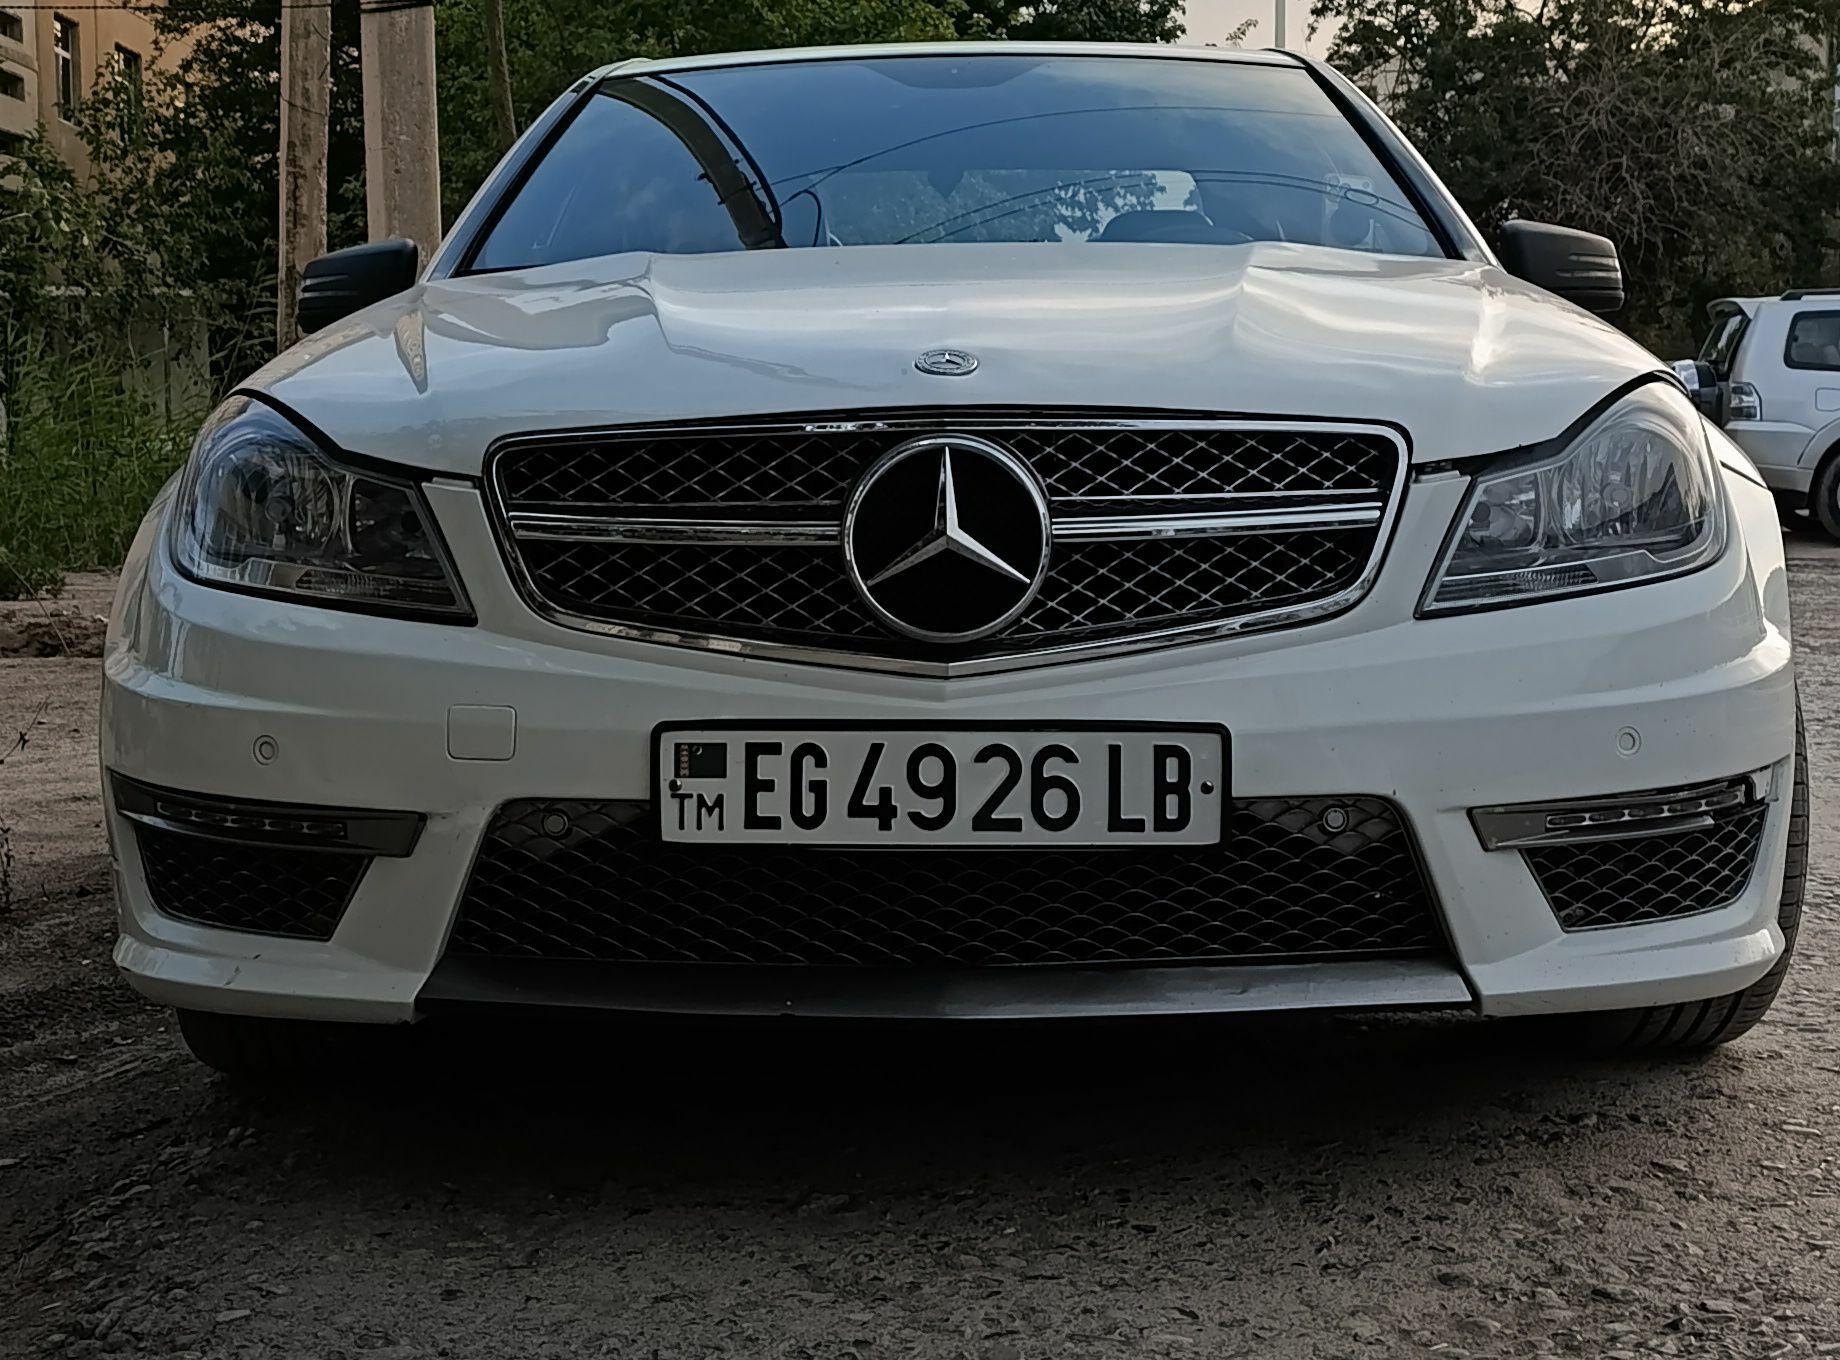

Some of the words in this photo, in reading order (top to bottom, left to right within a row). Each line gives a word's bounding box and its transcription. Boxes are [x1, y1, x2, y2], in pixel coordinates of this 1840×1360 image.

[669, 793, 725, 831] TM
[744, 741, 828, 831] EG
[847, 742, 1081, 832] 4926
[1107, 743, 1192, 833] LB
